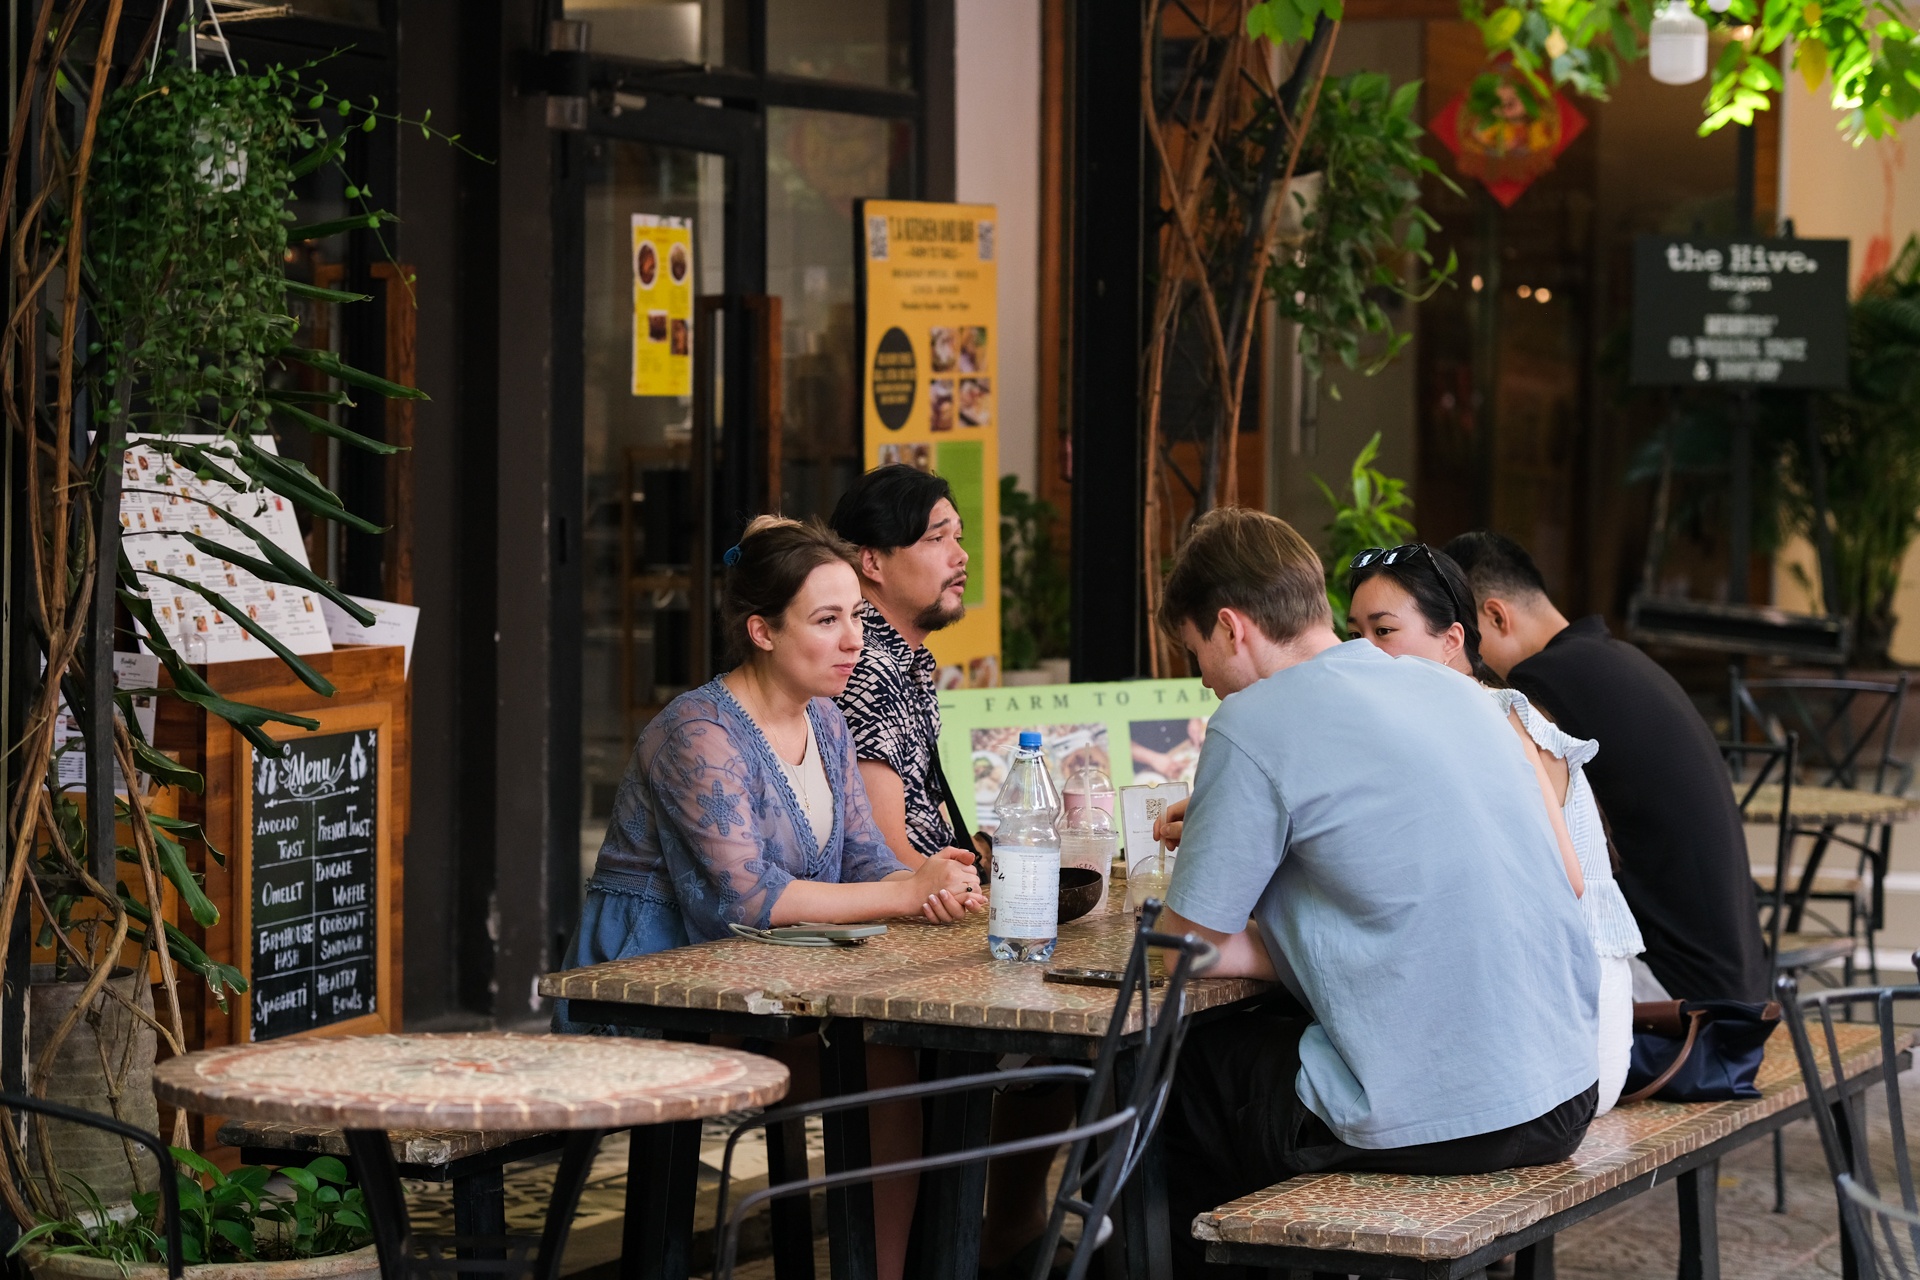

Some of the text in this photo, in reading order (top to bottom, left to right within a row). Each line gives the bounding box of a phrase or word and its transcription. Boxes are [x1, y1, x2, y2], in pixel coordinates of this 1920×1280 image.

[1665, 243, 1818, 273] the Hive.
[985, 687, 1212, 712] FARM TO TAB
[281, 750, 336, 790] Menu
[257, 816, 299, 836] AVOCADO
[318, 815, 347, 842] FRENCH
[277, 839, 305, 860] TOAST
[332, 883, 366, 907] WAFFLE
[259, 922, 314, 955] FARMHOUSE
[274, 949, 300, 971] HASH
